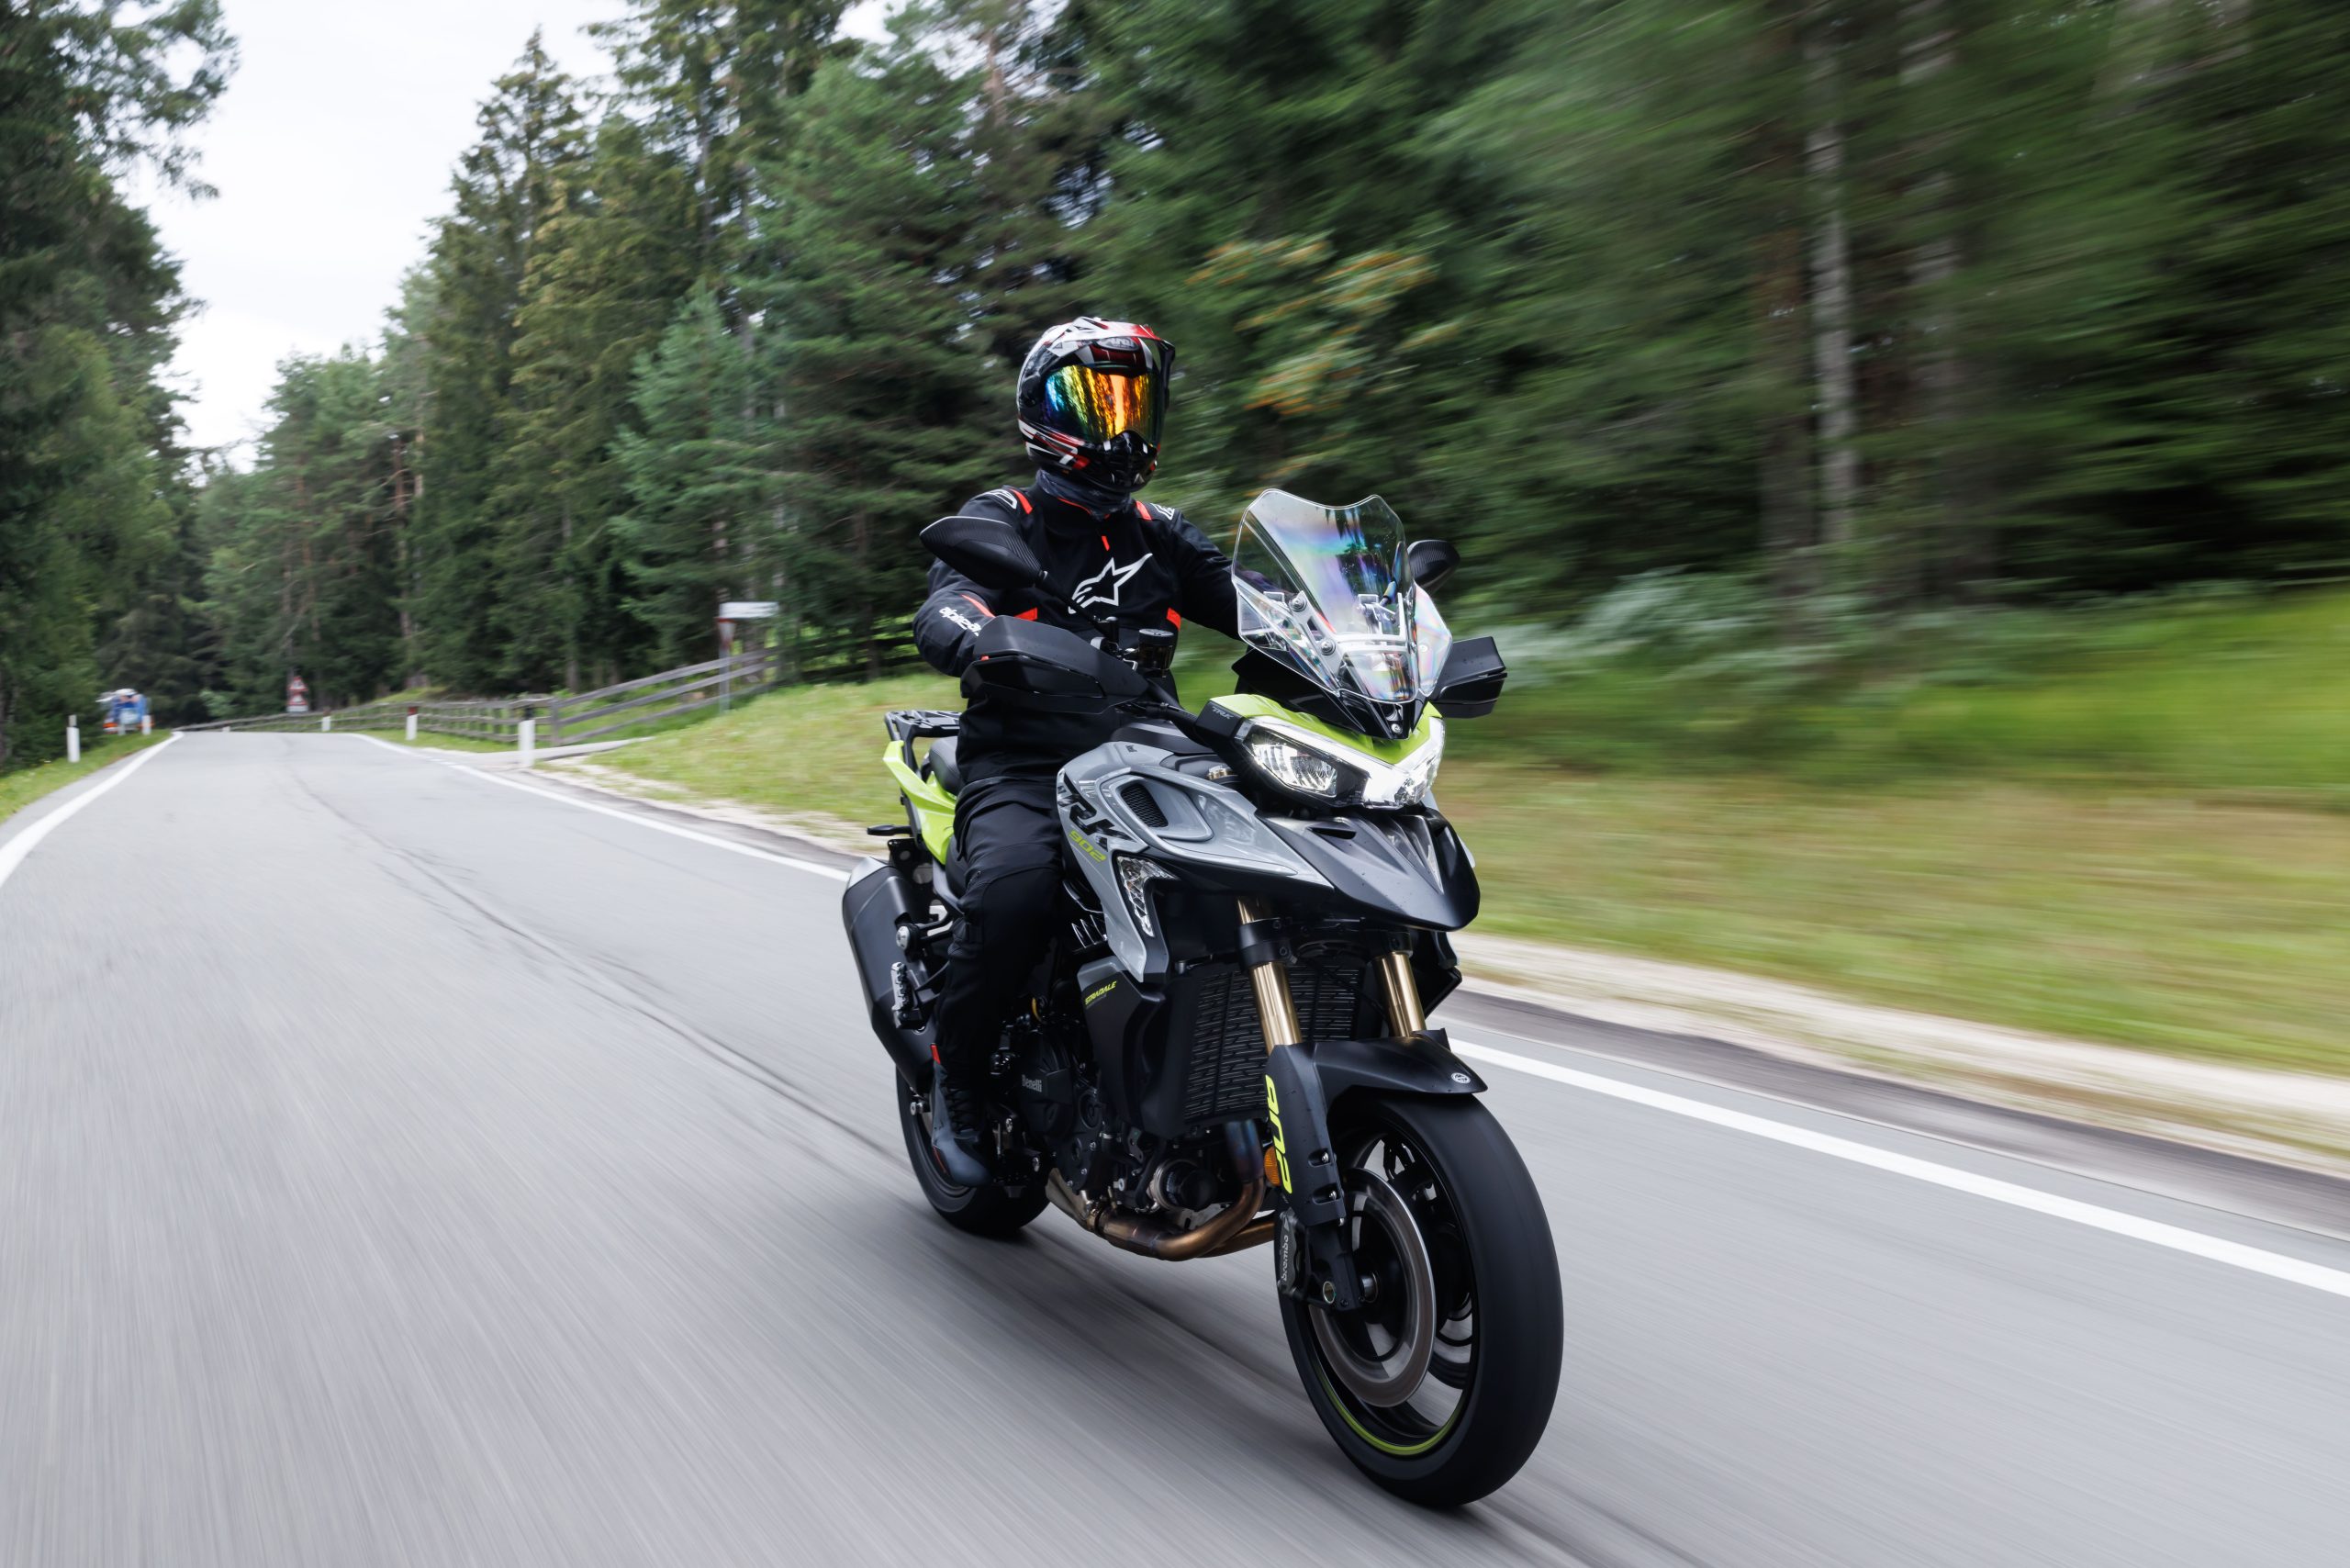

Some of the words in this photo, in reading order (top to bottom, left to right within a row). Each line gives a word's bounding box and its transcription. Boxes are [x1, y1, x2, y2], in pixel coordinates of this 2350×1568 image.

[1212, 706, 1234, 719] TRK
[1069, 830, 1106, 863] 902
[1085, 980, 1117, 1005] STRADALE
[1281, 1235, 1289, 1282] brembo
